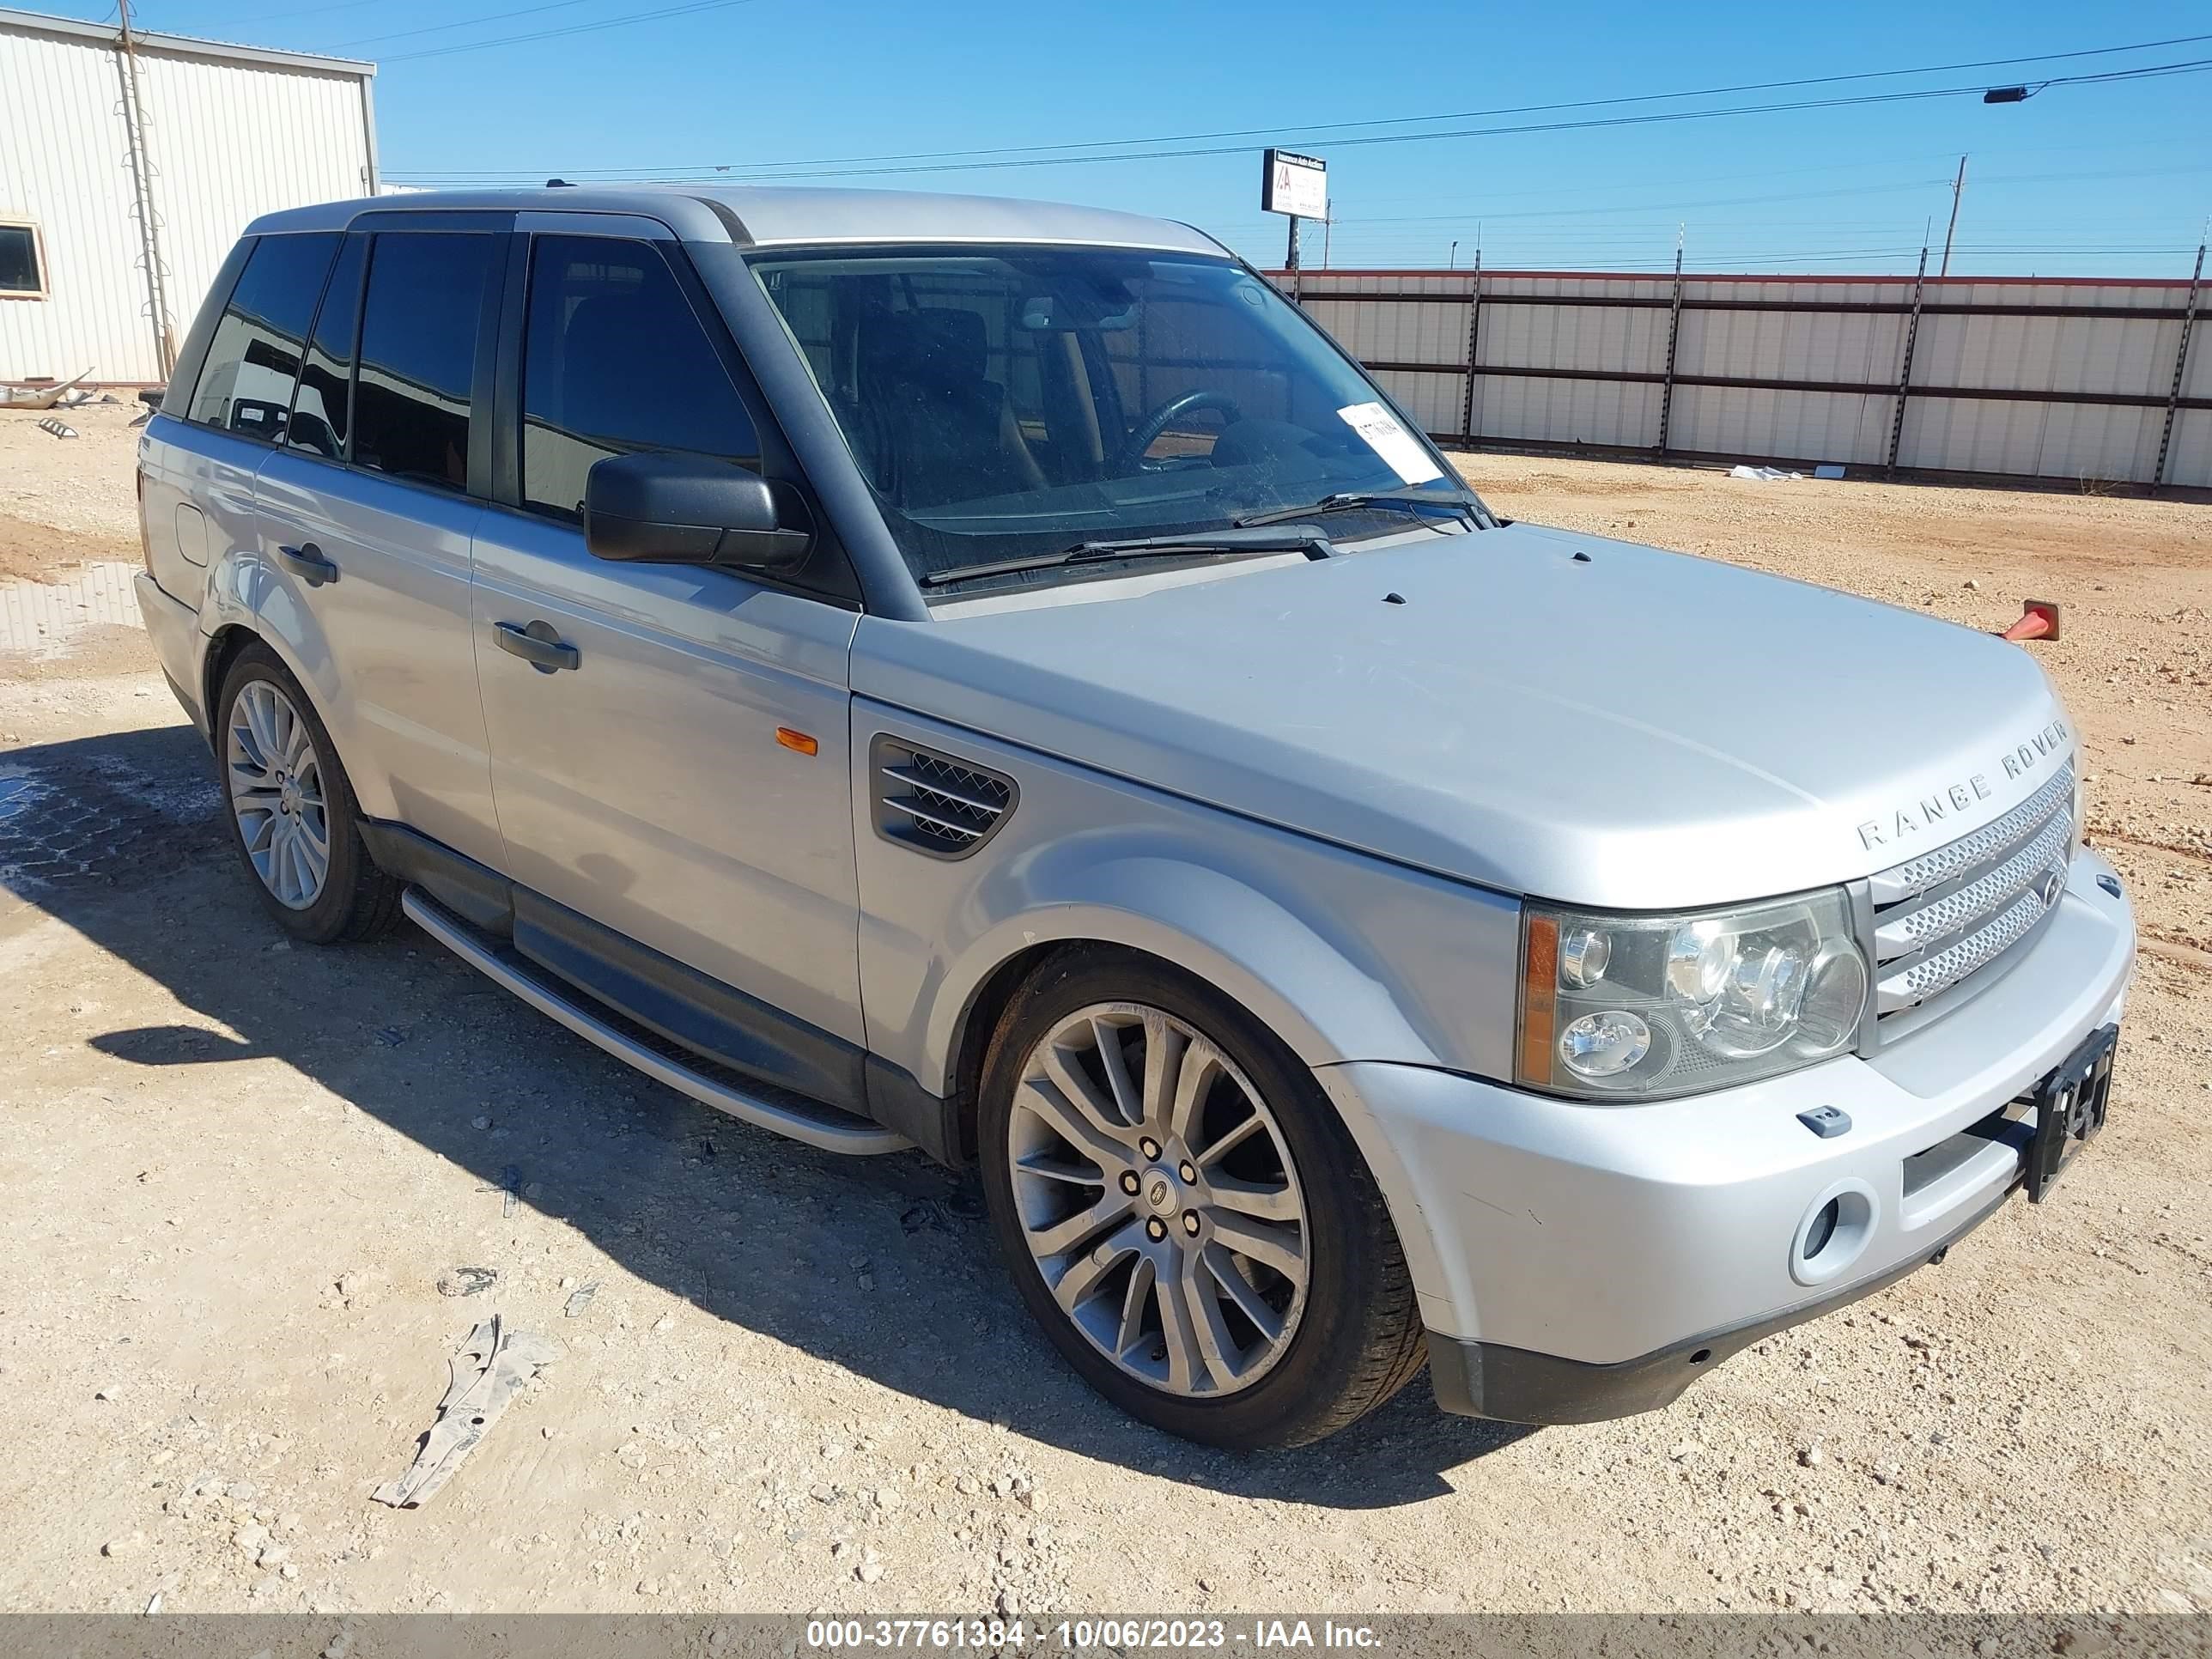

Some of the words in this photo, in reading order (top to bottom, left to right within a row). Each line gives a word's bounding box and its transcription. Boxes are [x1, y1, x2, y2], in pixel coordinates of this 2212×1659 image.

[1297, 156, 1308, 166] Auto
[1856, 773, 1992, 852] RANGE
[2000, 718, 2069, 781] ROVER
